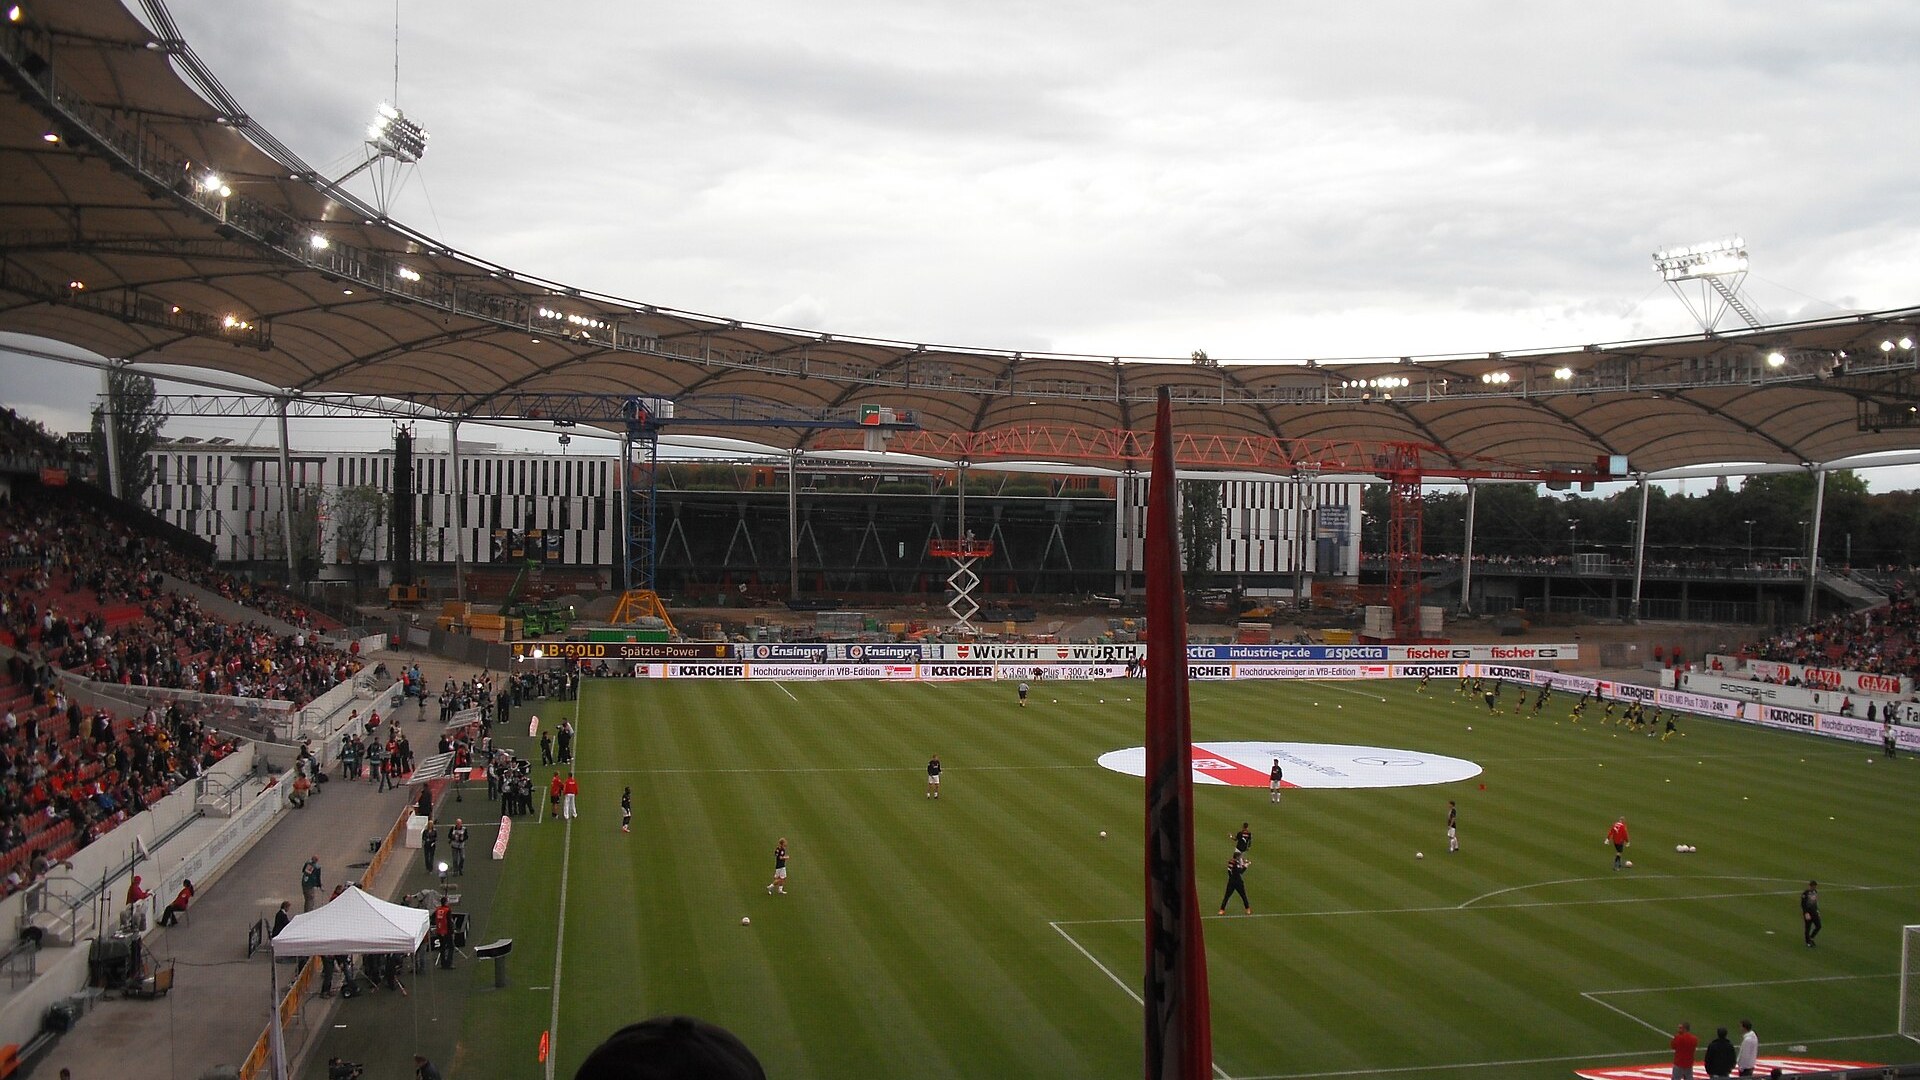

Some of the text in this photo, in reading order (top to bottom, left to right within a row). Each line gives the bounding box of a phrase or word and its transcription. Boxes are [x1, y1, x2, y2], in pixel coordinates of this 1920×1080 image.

[620, 646, 700, 659] Spätzle-Power
[771, 646, 824, 659] Ensinger
[864, 646, 917, 659] Ensinger
[973, 645, 1039, 659] WÜRTH
[1073, 645, 1137, 659] WÜRTH
[1230, 647, 1311, 660] industrie-pc.de
[1335, 647, 1382, 661] spectra
[1407, 647, 1450, 659] fischer
[1491, 646, 1536, 659] fischer
[679, 664, 744, 676] KÄRCHER
[753, 666, 825, 678] Hochdruckreiniger
[826, 667, 835, 676] in
[836, 666, 880, 677] VfB-Edition
[931, 665, 993, 677] KÄRCHER
[1002, 667, 1008, 676] K
[1043, 667, 1060, 676] Plus
[1061, 667, 1067, 676] T
[1068, 667, 1082, 676] 300
[1189, 666, 1230, 677] RCHER
[1239, 667, 1306, 679] Hochdruckreiniger
[1307, 667, 1315, 677] in
[1316, 667, 1356, 677] VfB-Edition
[1403, 665, 1458, 677] KÄRCHER
[1489, 665, 1530, 679] KÄRCHER
[1807, 669, 1838, 687] GAZI
[1860, 676, 1895, 693] GAZI
[1620, 685, 1655, 701] KÄRCHER
[1721, 683, 1777, 699] PORSCHE
[1770, 708, 1815, 727] KÄRCHER
